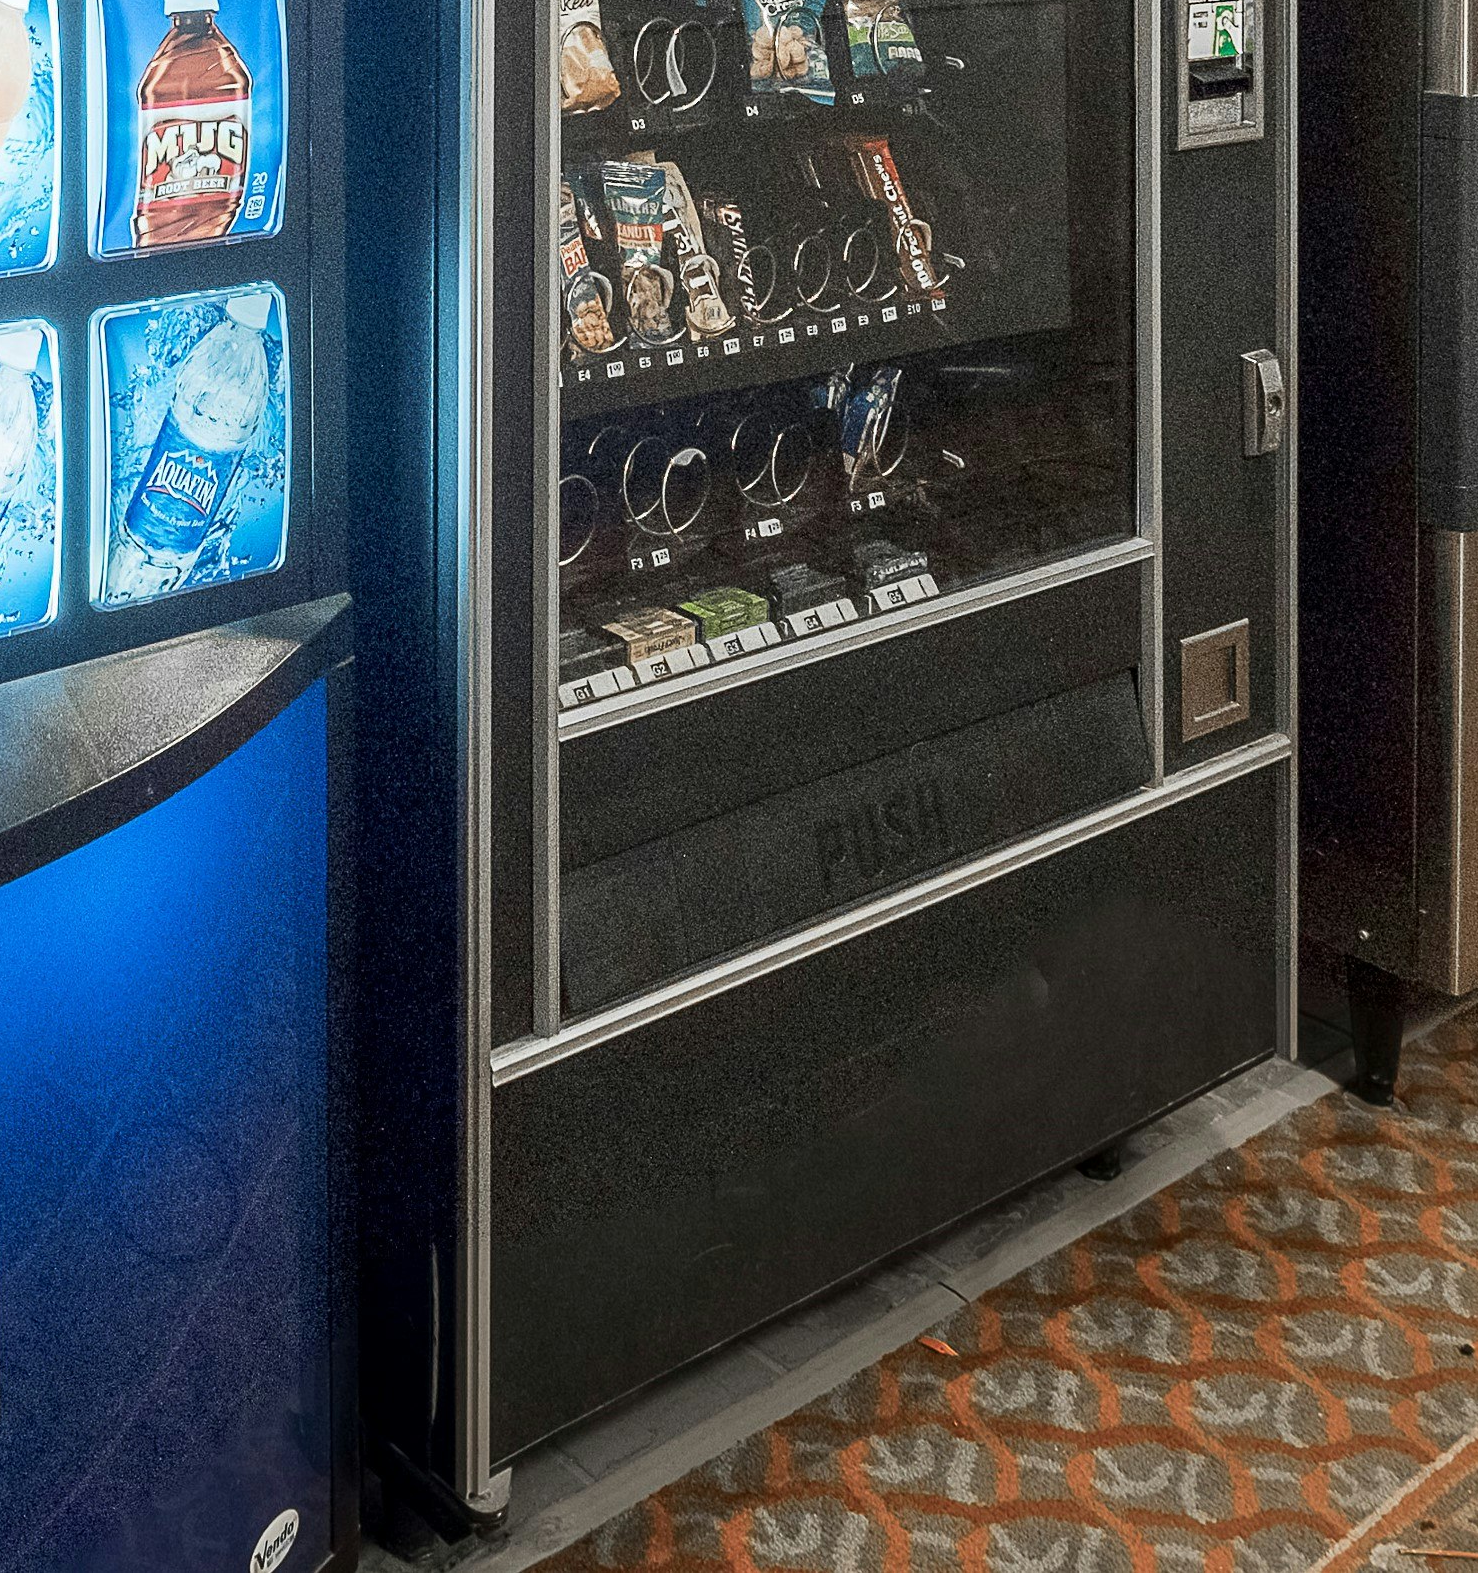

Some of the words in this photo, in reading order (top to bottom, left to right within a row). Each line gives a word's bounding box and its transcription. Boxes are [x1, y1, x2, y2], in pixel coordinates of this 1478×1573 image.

[745, 105, 759, 117] D4
[631, 118, 646, 130] D3
[145, 120, 244, 177] MUG
[252, 171, 269, 186] 20
[873, 154, 898, 202] Chews
[564, 248, 588, 276] BA
[639, 356, 652, 368] E5
[578, 369, 591, 382] E4
[146, 450, 219, 515] AQUAFINA
[631, 558, 644, 570] F3
[889, 590, 902, 603] G5
[726, 641, 740, 654] G3
[652, 663, 667, 676] G2
[813, 779, 951, 893] PUSH
[254, 1520, 295, 1570] Vendo
